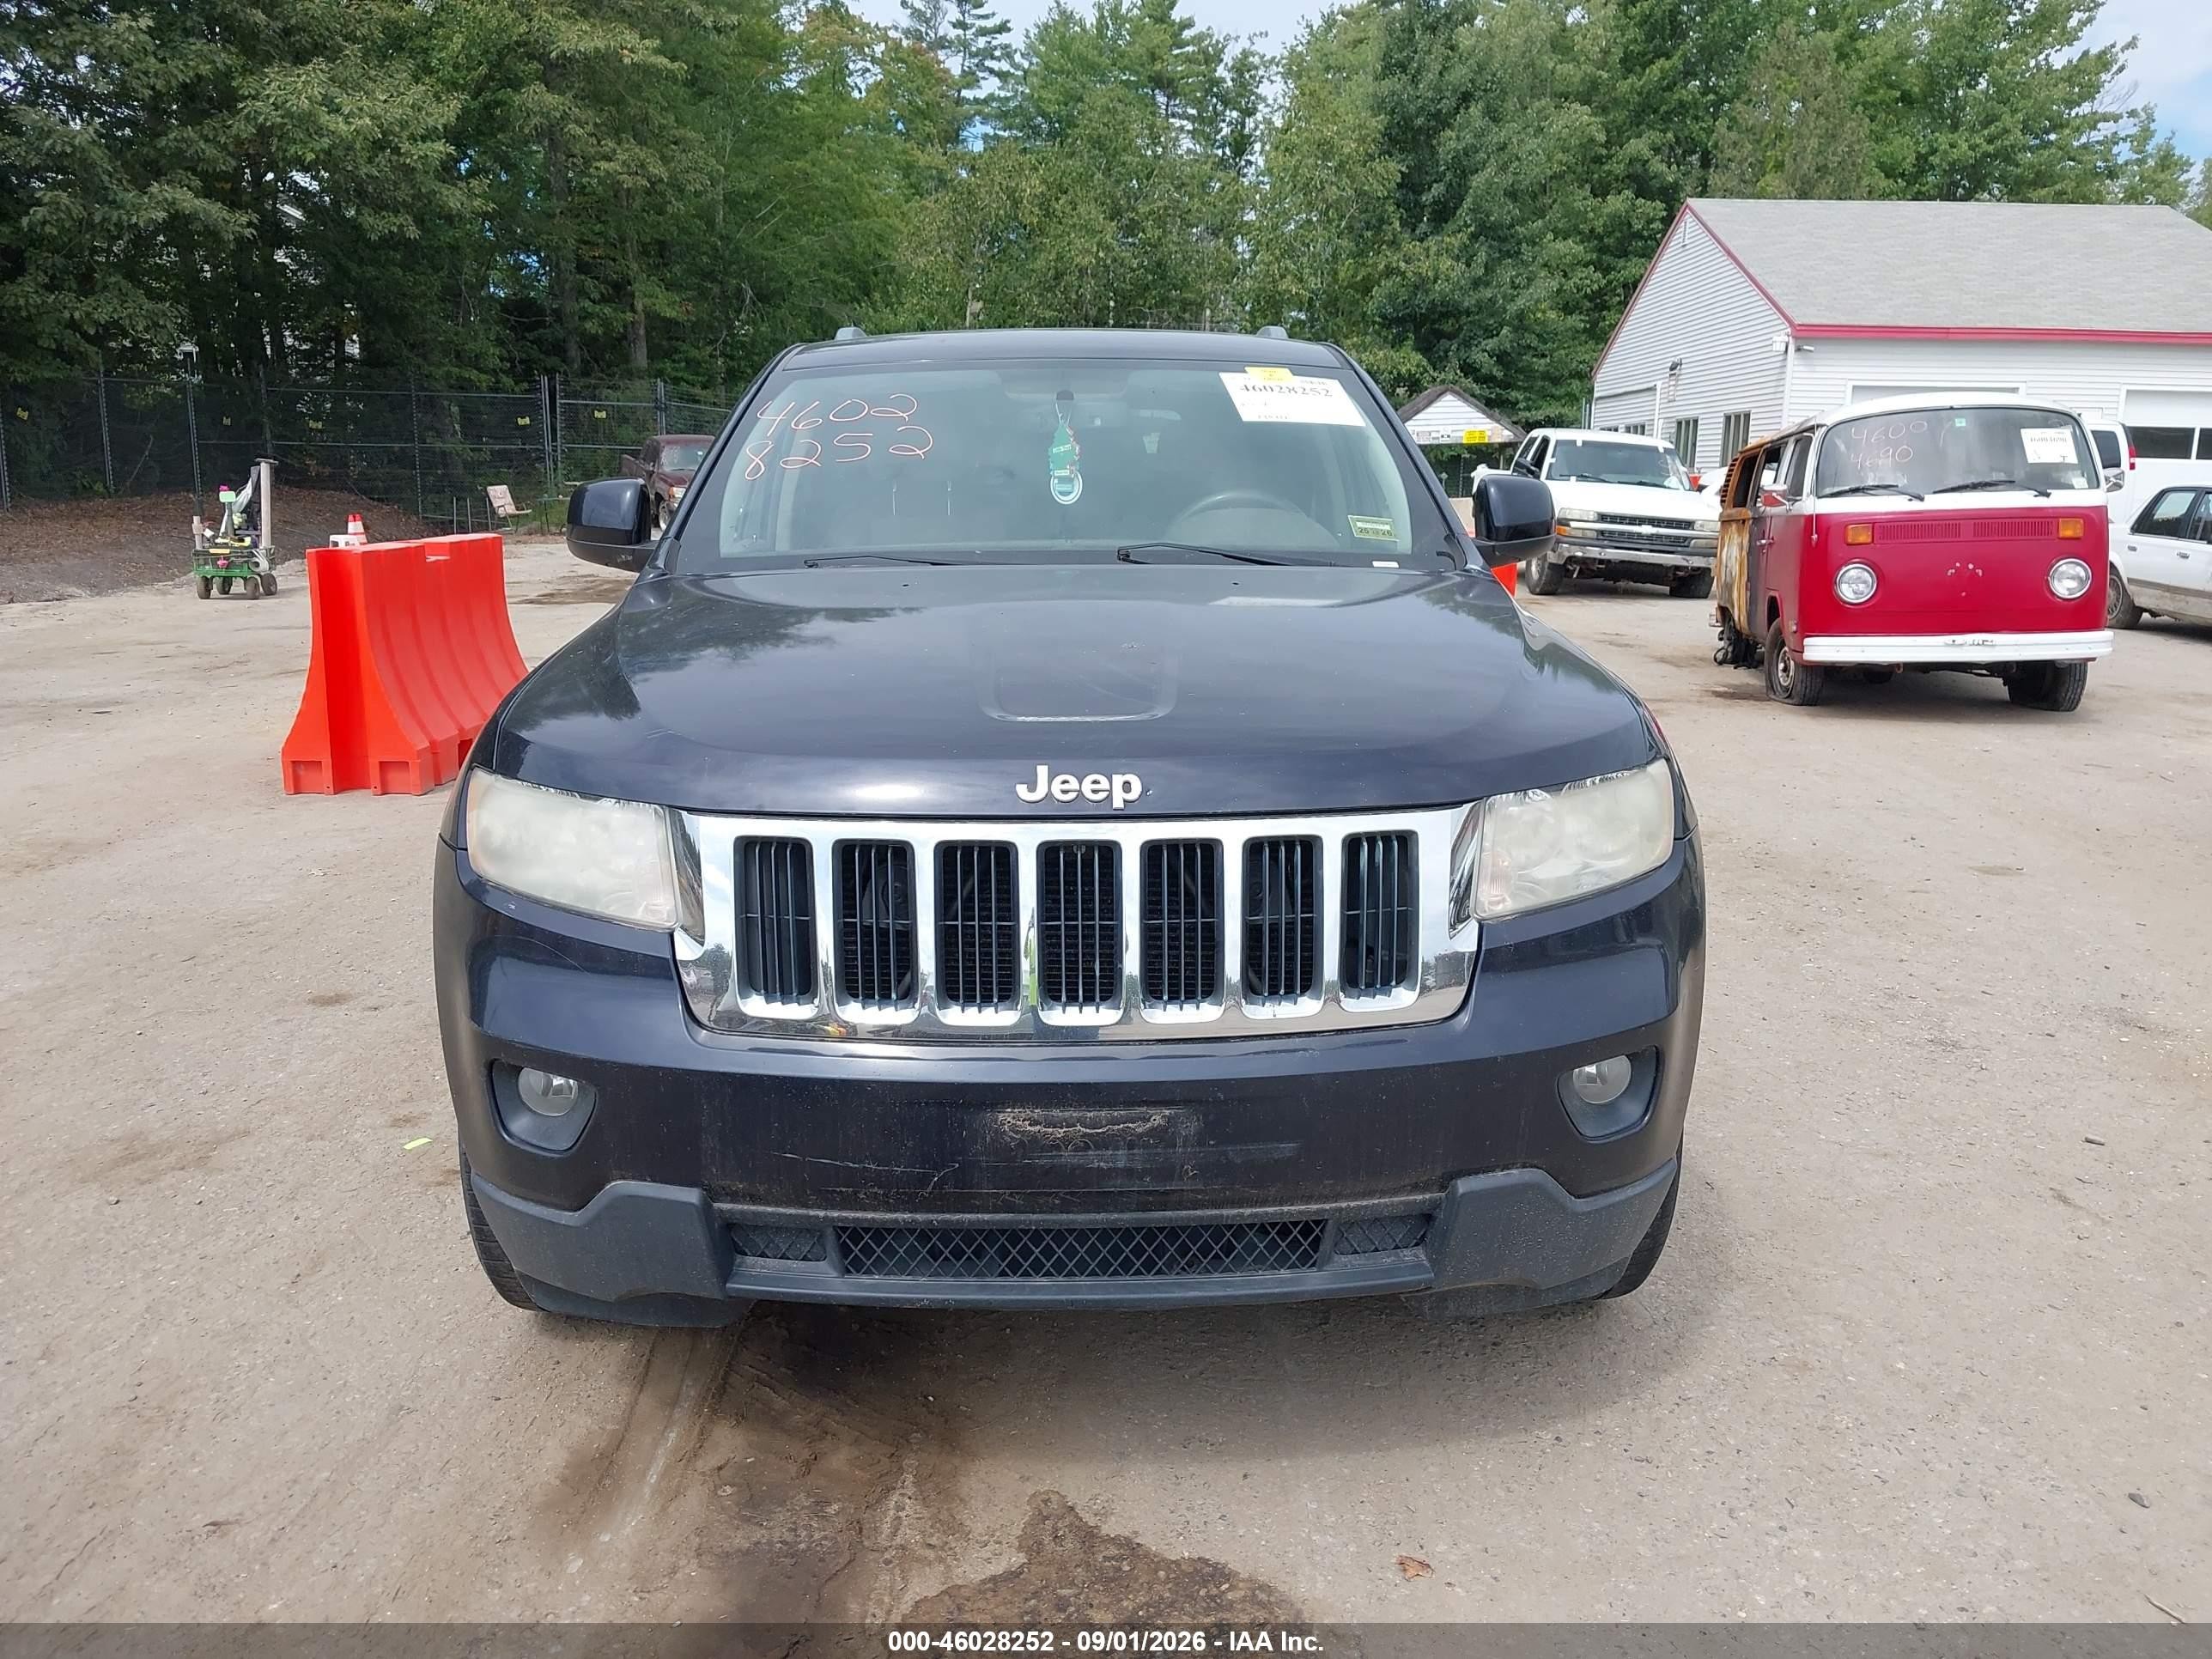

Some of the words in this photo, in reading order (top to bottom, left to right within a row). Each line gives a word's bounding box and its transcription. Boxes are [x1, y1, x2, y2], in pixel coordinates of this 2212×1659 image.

[757, 393, 919, 437] 4602
[744, 425, 934, 481] 8252
[1016, 764, 1143, 810] Jeep
